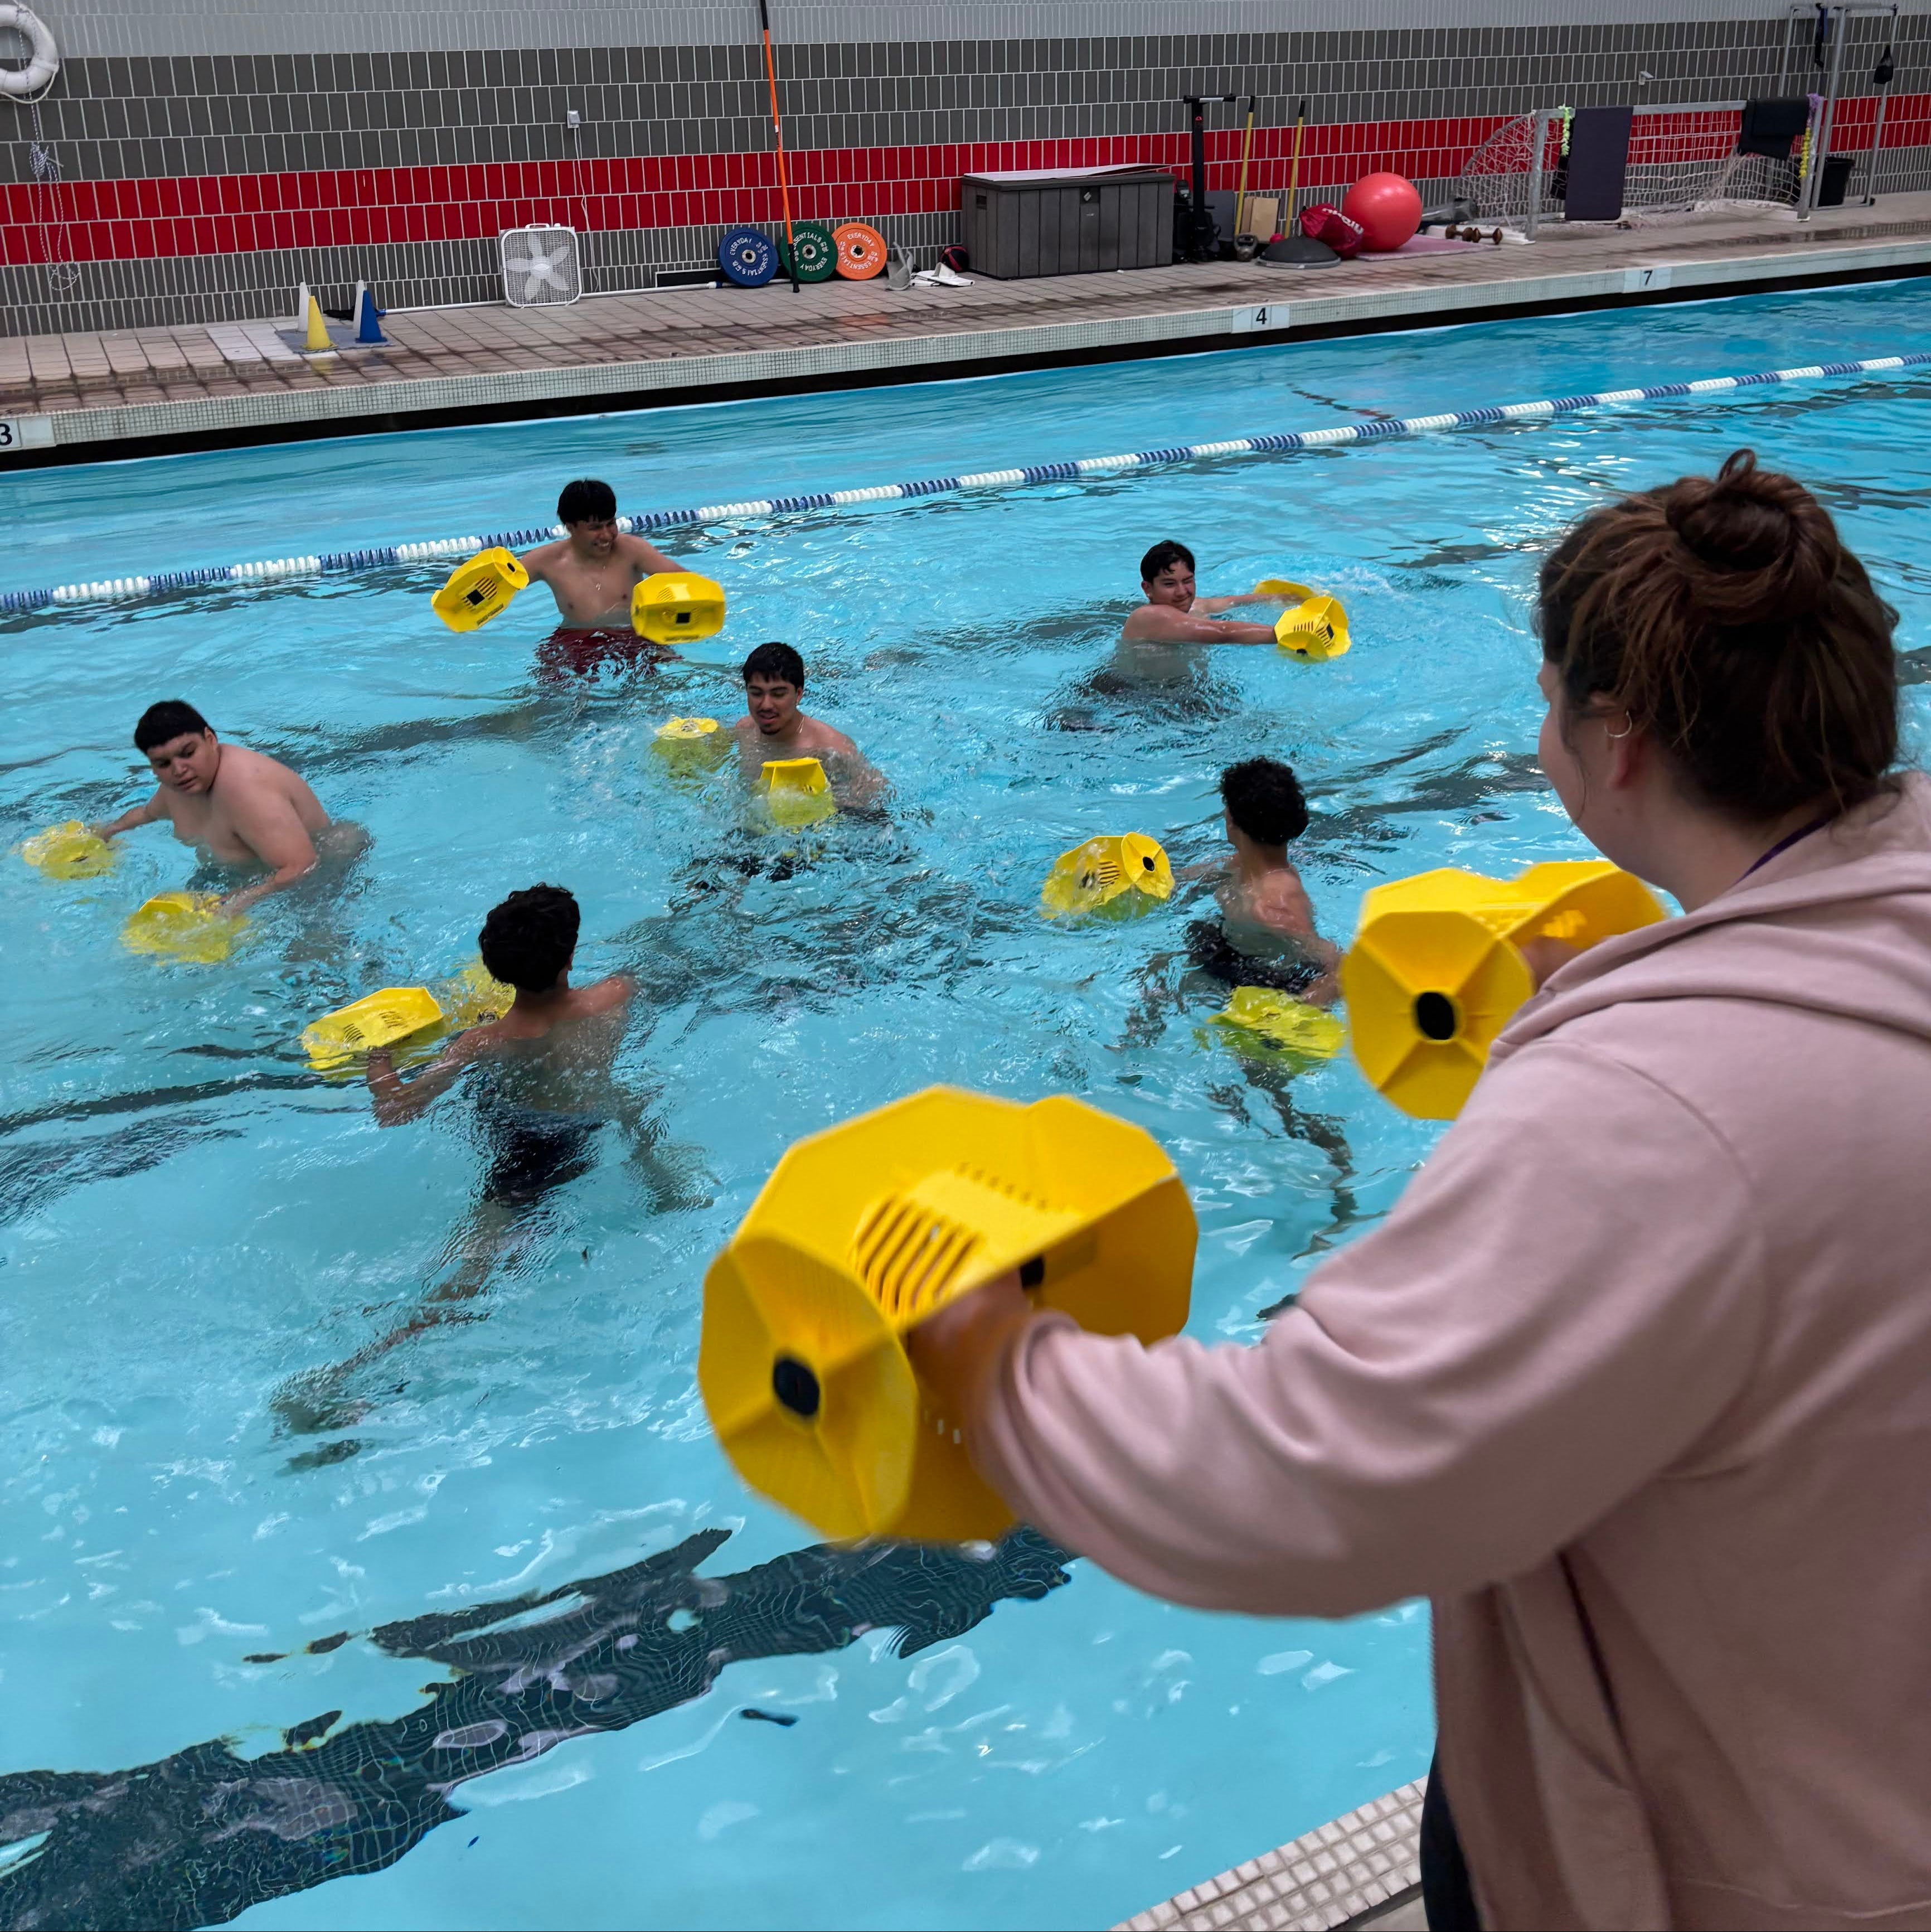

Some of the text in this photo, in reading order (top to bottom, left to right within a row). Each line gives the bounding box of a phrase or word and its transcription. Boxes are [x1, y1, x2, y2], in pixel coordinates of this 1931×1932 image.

[730, 237, 752, 255] EVERYDAY
[847, 232, 875, 247] EVERYDAY
[800, 257, 828, 272] EVERYDAY
[1643, 270, 1653, 285] 7
[1256, 307, 1267, 325] 4
[0, 423, 12, 446] 3
